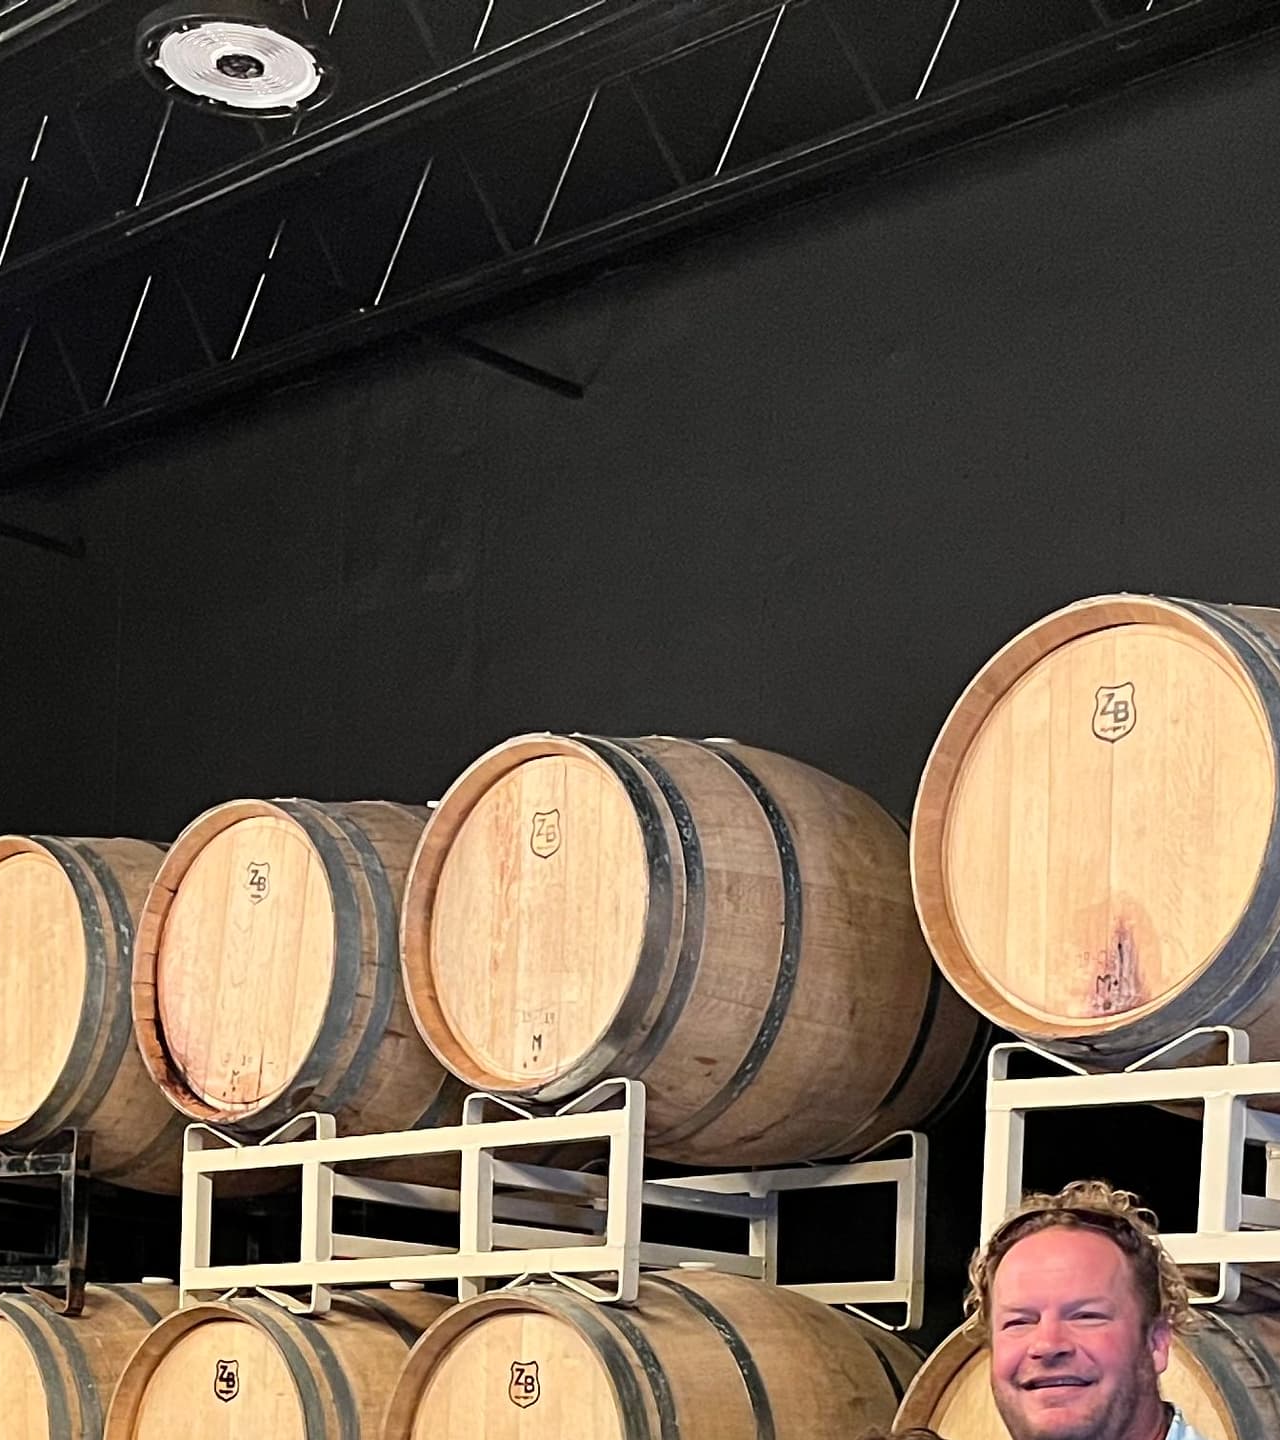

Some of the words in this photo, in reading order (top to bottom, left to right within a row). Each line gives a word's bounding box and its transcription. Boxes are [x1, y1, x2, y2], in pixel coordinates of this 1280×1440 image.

[1100, 692, 1129, 724] ZB
[249, 869, 267, 891] ZB
[218, 1364, 236, 1389] ZB
[514, 1367, 535, 1394] ZB
